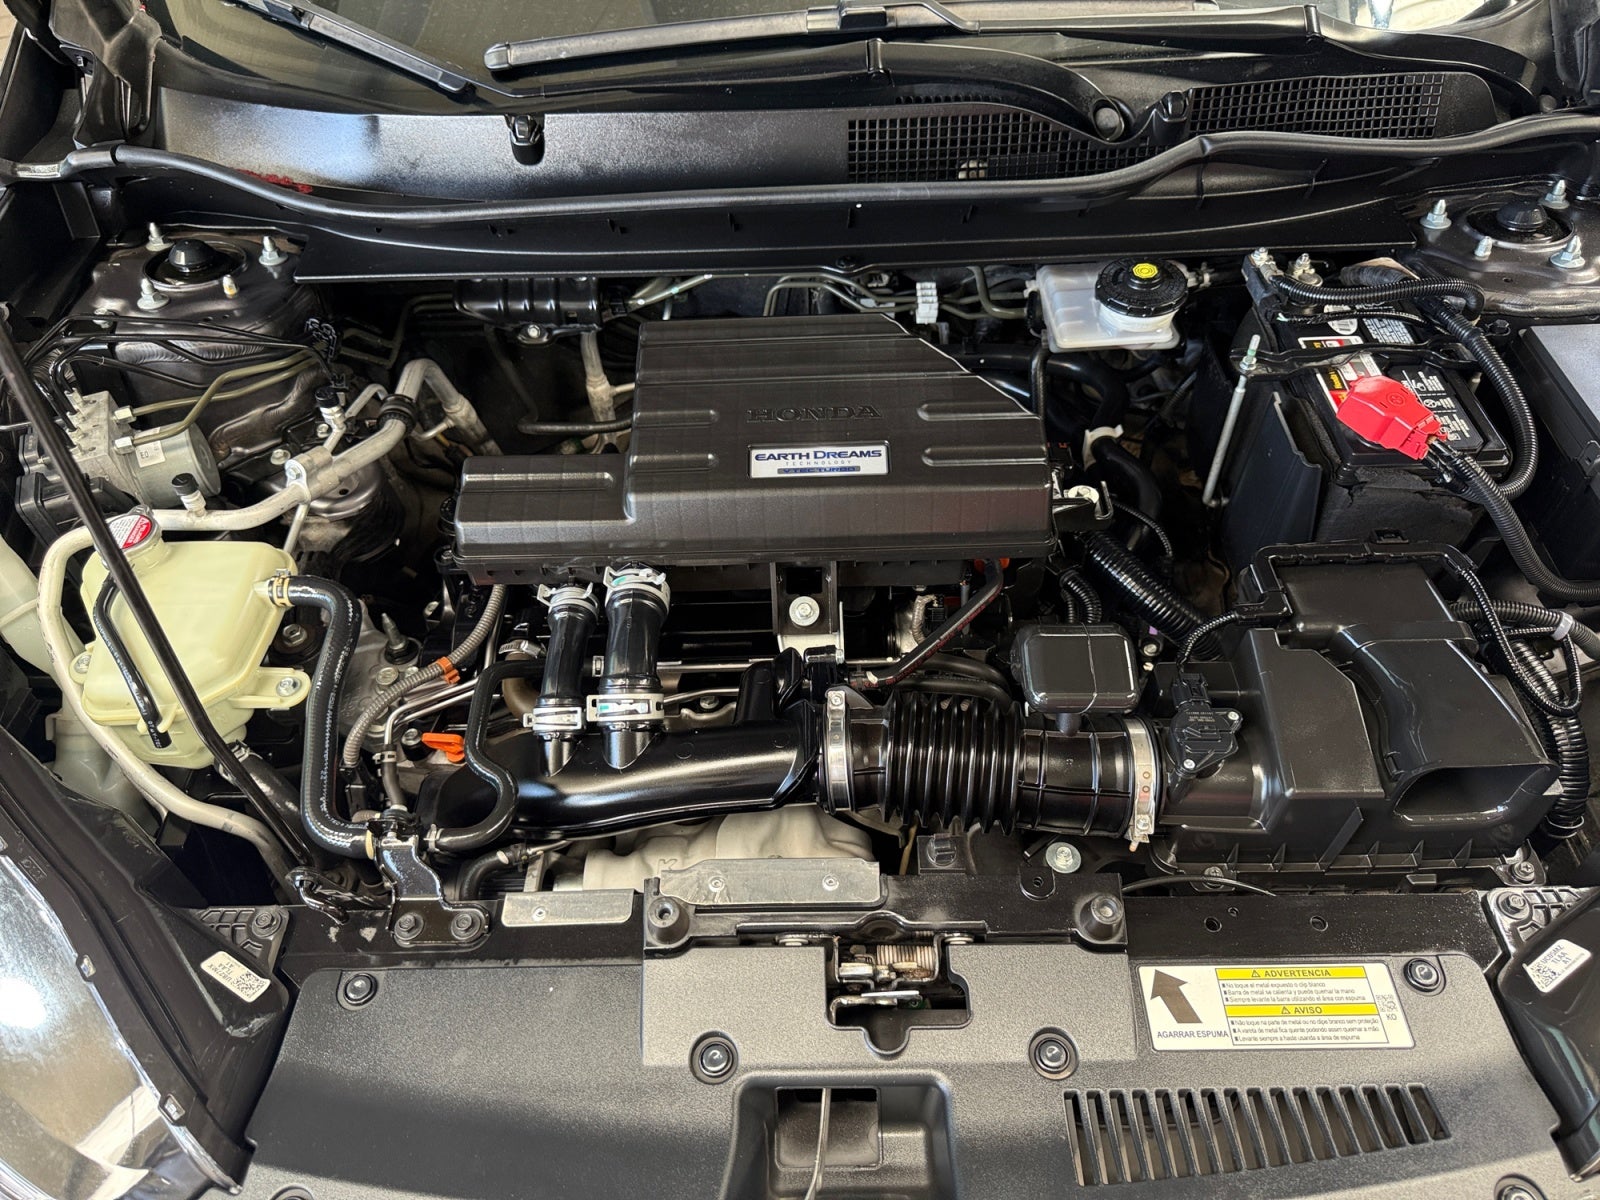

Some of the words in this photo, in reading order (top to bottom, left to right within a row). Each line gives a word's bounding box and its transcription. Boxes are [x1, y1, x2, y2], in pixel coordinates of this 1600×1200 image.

[747, 405, 882, 423] HONDA
[754, 452, 810, 461] EARTH
[813, 449, 882, 460] DREAMS
[1264, 968, 1332, 978] ADVERTENCIA
[1234, 981, 1249, 990] toque
[1271, 981, 1293, 989] expuesto
[1298, 988, 1313, 996] puede
[1229, 996, 1250, 1005] Siempre
[1293, 1005, 1322, 1015] AVISO
[1157, 1030, 1195, 1038] AGARRAR
[1196, 1029, 1229, 1038] ESPUMA
